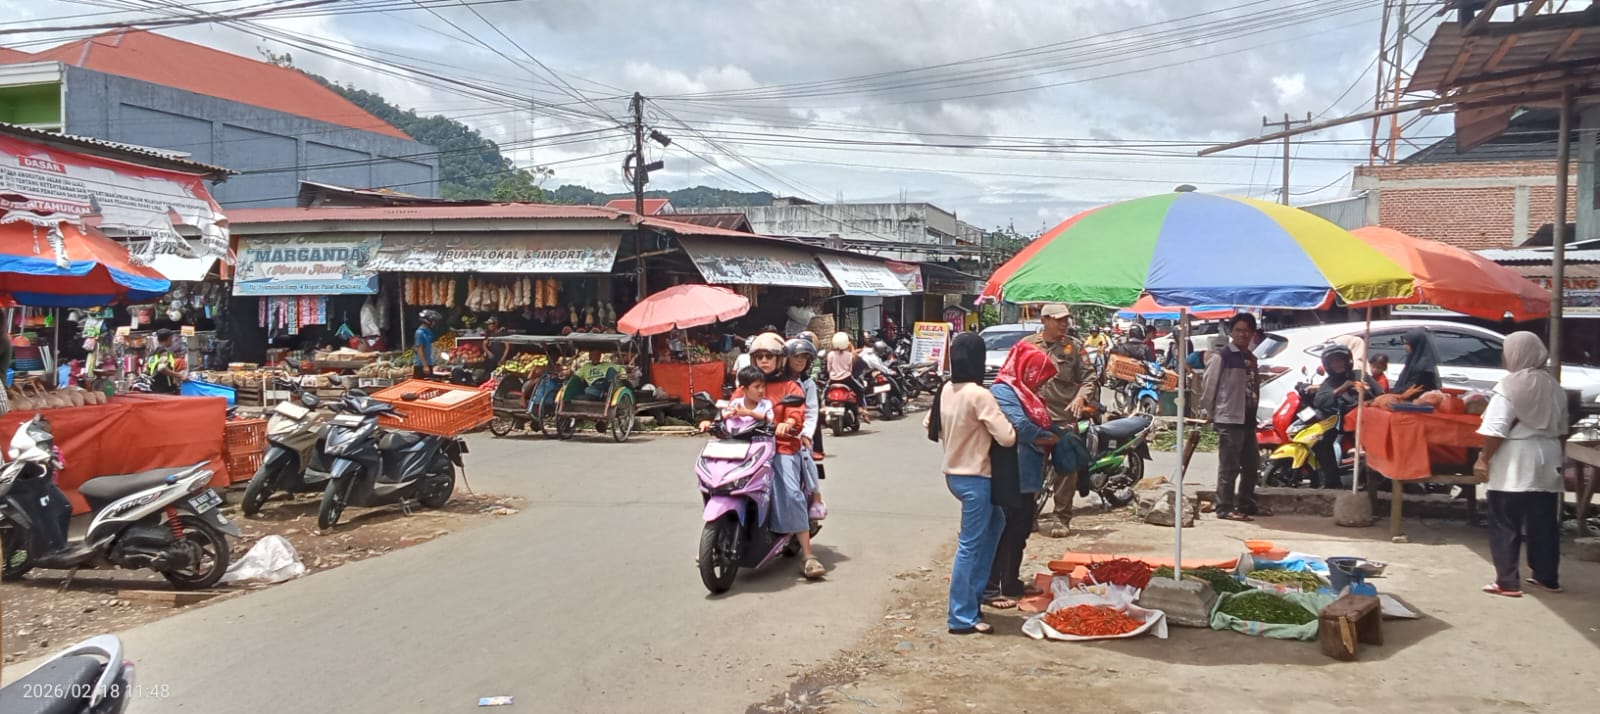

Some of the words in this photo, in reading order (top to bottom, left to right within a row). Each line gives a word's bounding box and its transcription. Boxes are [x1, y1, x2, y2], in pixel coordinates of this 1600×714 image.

[24, 159, 61, 172] DASAR
[481, 249, 519, 260] LOKAL
[524, 250, 532, 260] &
[537, 249, 584, 260] IMPORT
